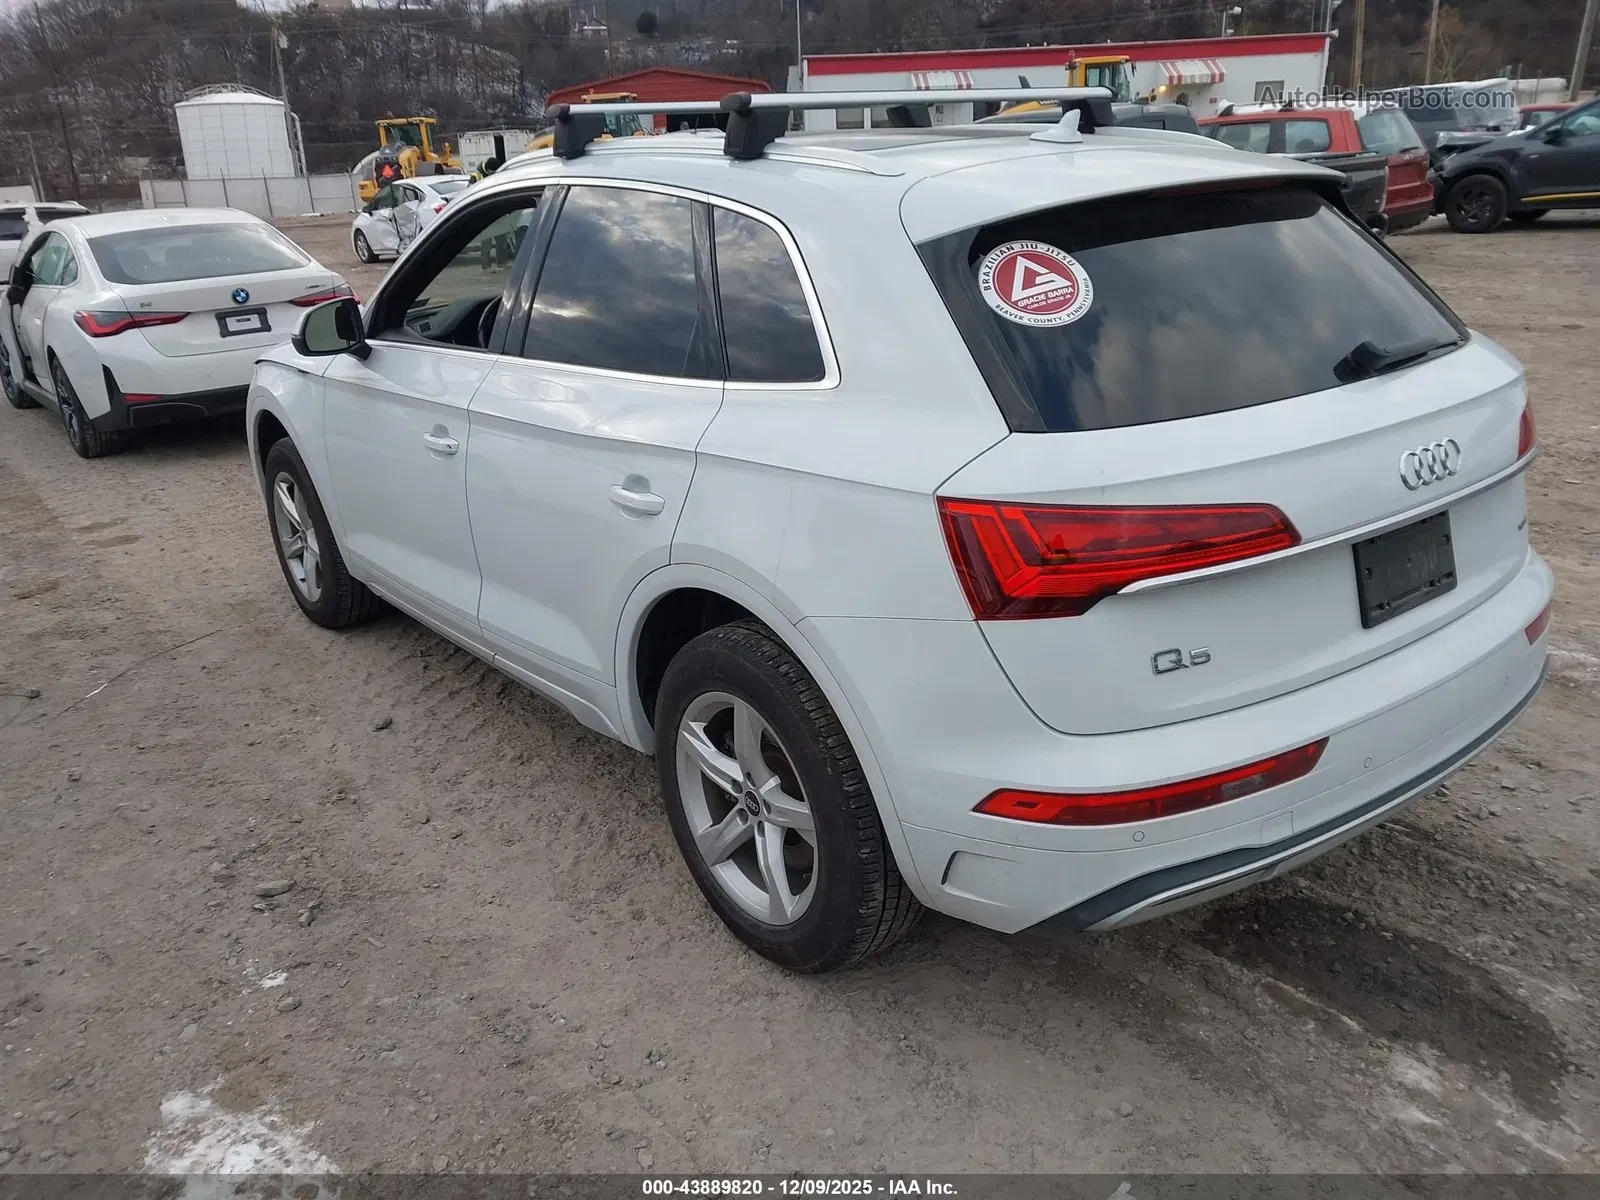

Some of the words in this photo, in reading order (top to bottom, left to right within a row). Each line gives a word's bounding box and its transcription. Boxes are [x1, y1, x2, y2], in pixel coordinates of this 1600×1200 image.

[982, 245, 1015, 291] BRAZILIAN
[1019, 243, 1075, 267] JIU-JITSU
[1017, 293, 1047, 307] GRACIE
[1047, 287, 1075, 298] BARRA
[995, 303, 1025, 321] BEAVER
[1151, 646, 1212, 675] Q5
